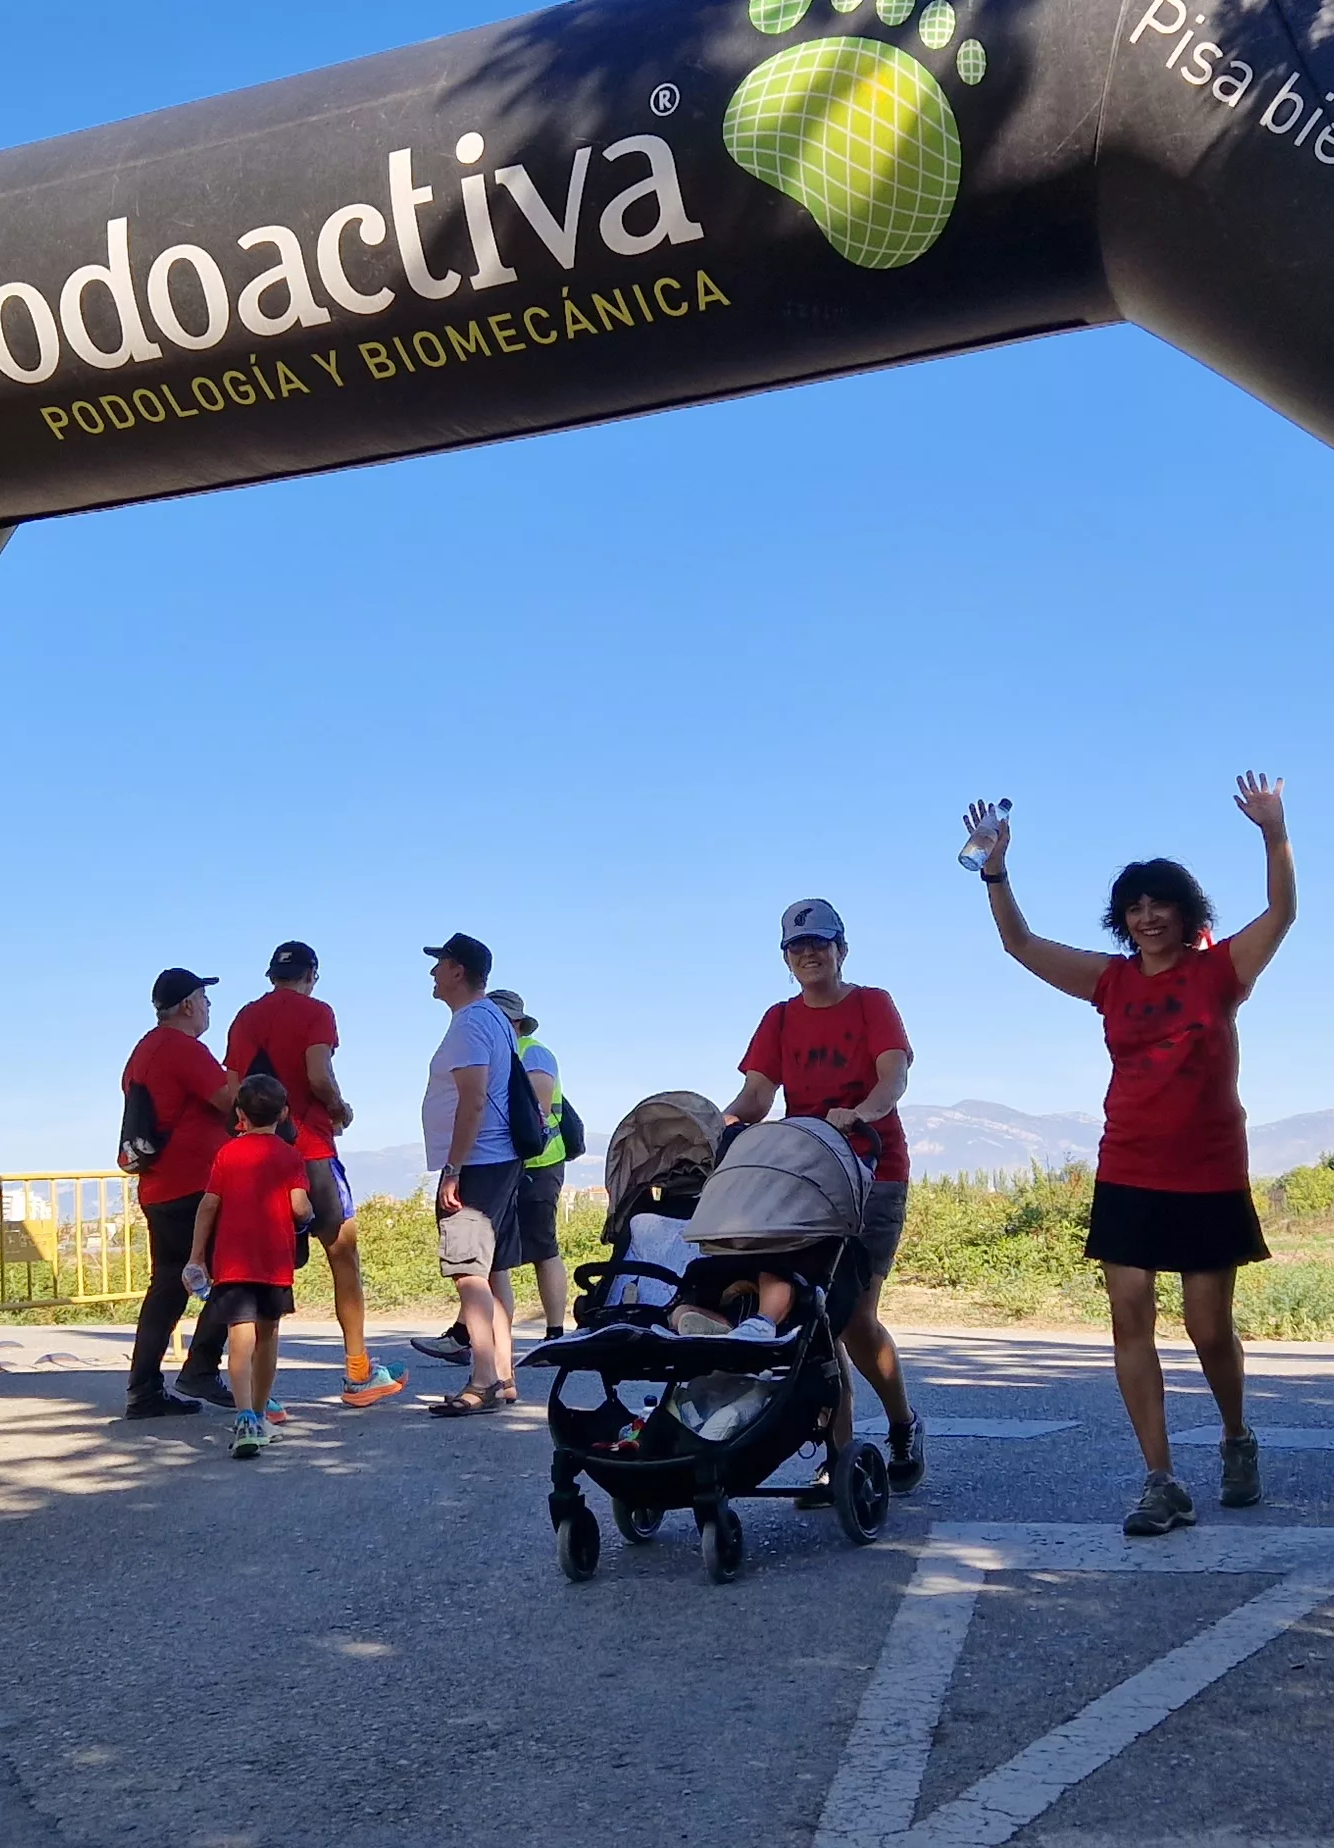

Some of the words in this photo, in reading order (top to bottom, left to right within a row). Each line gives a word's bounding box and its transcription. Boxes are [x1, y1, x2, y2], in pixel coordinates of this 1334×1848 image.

[1129, 0, 1255, 109] Pisa
[40, 354, 310, 441] PODOLOGÍA
[312, 350, 345, 388] Y
[358, 270, 731, 380] BIOMECÁNICA
